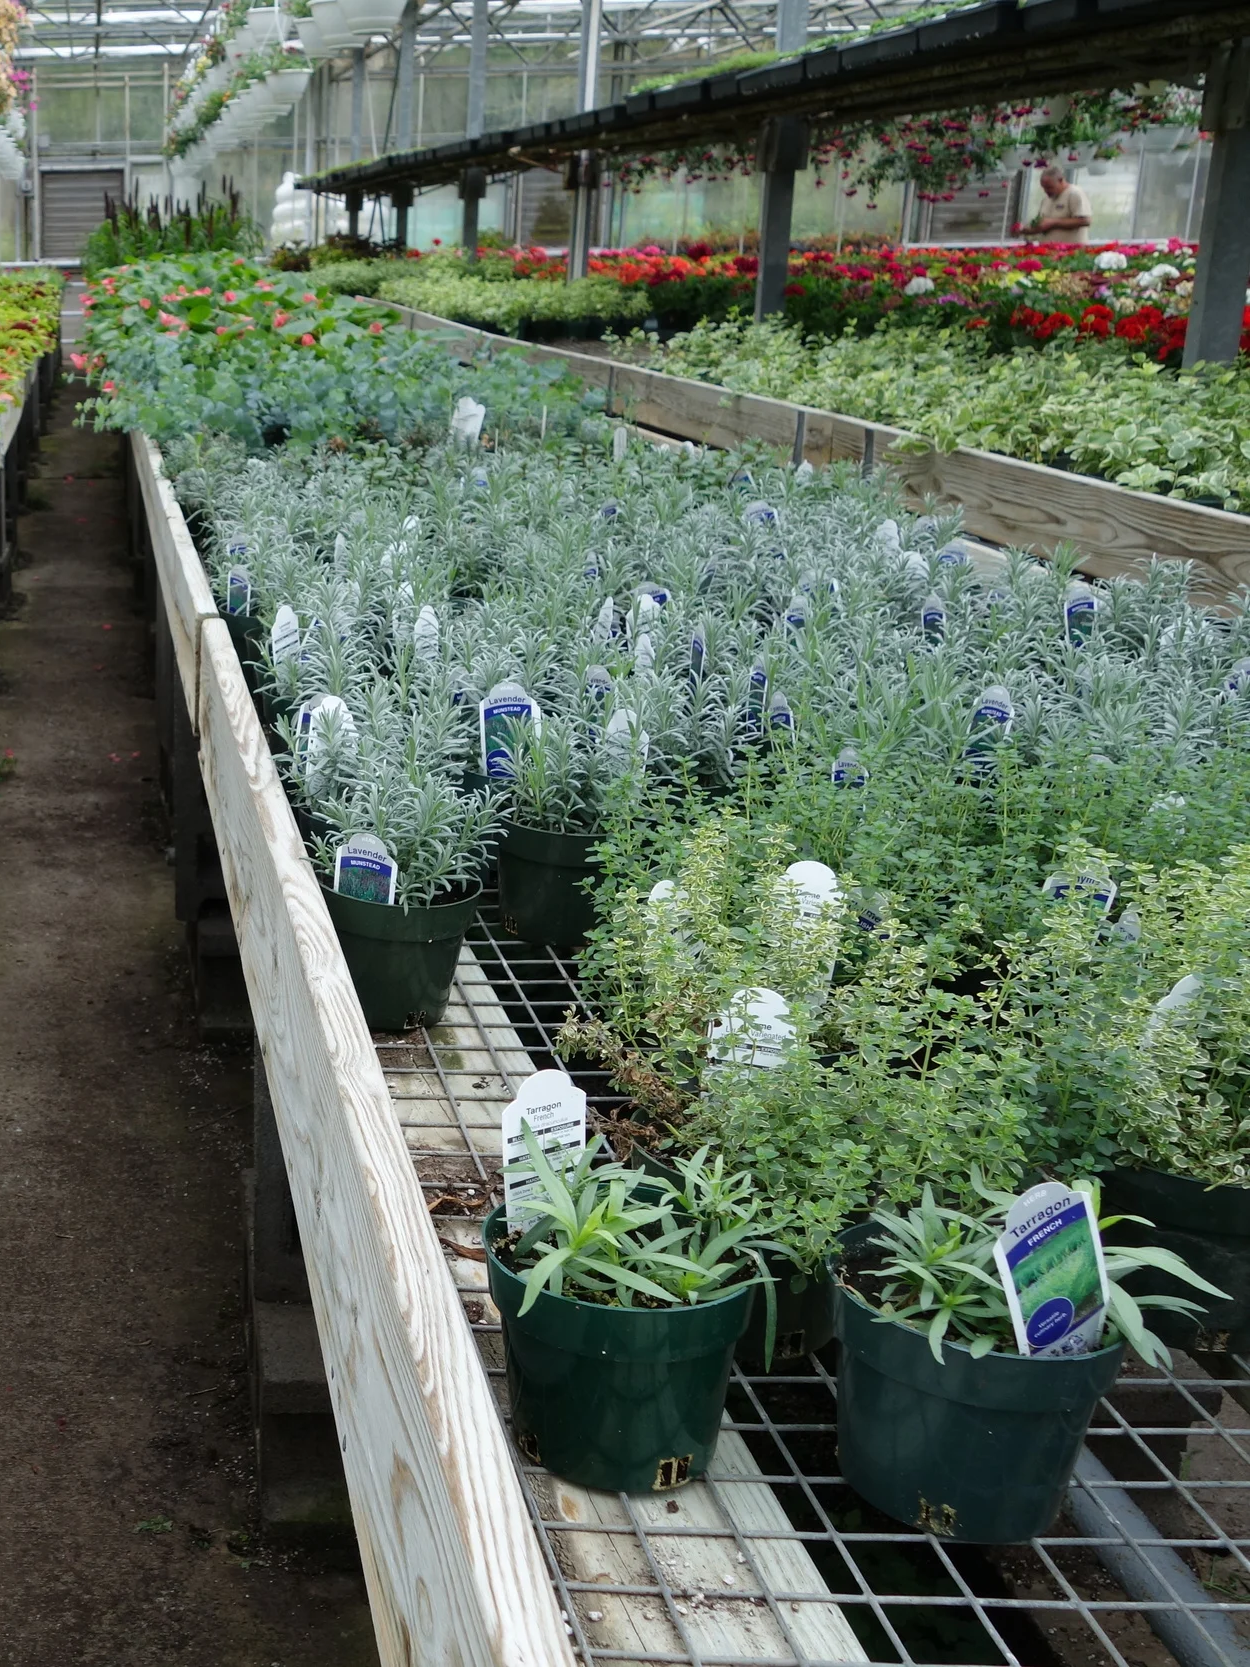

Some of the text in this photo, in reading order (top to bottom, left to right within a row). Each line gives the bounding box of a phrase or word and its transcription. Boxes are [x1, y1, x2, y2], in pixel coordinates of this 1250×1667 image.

[488, 695, 526, 705] Lavender
[981, 698, 1009, 710] Lavender
[492, 706, 522, 715] MUNSTEAD
[347, 846, 388, 863] Lavender
[350, 859, 382, 871] MUNSTEAD
[526, 1101, 562, 1115] Tarragon
[533, 1111, 555, 1122] French
[1023, 1189, 1048, 1207] HERB
[1010, 1197, 1071, 1238] Tarragon
[1027, 1218, 1063, 1247] FRENCH
